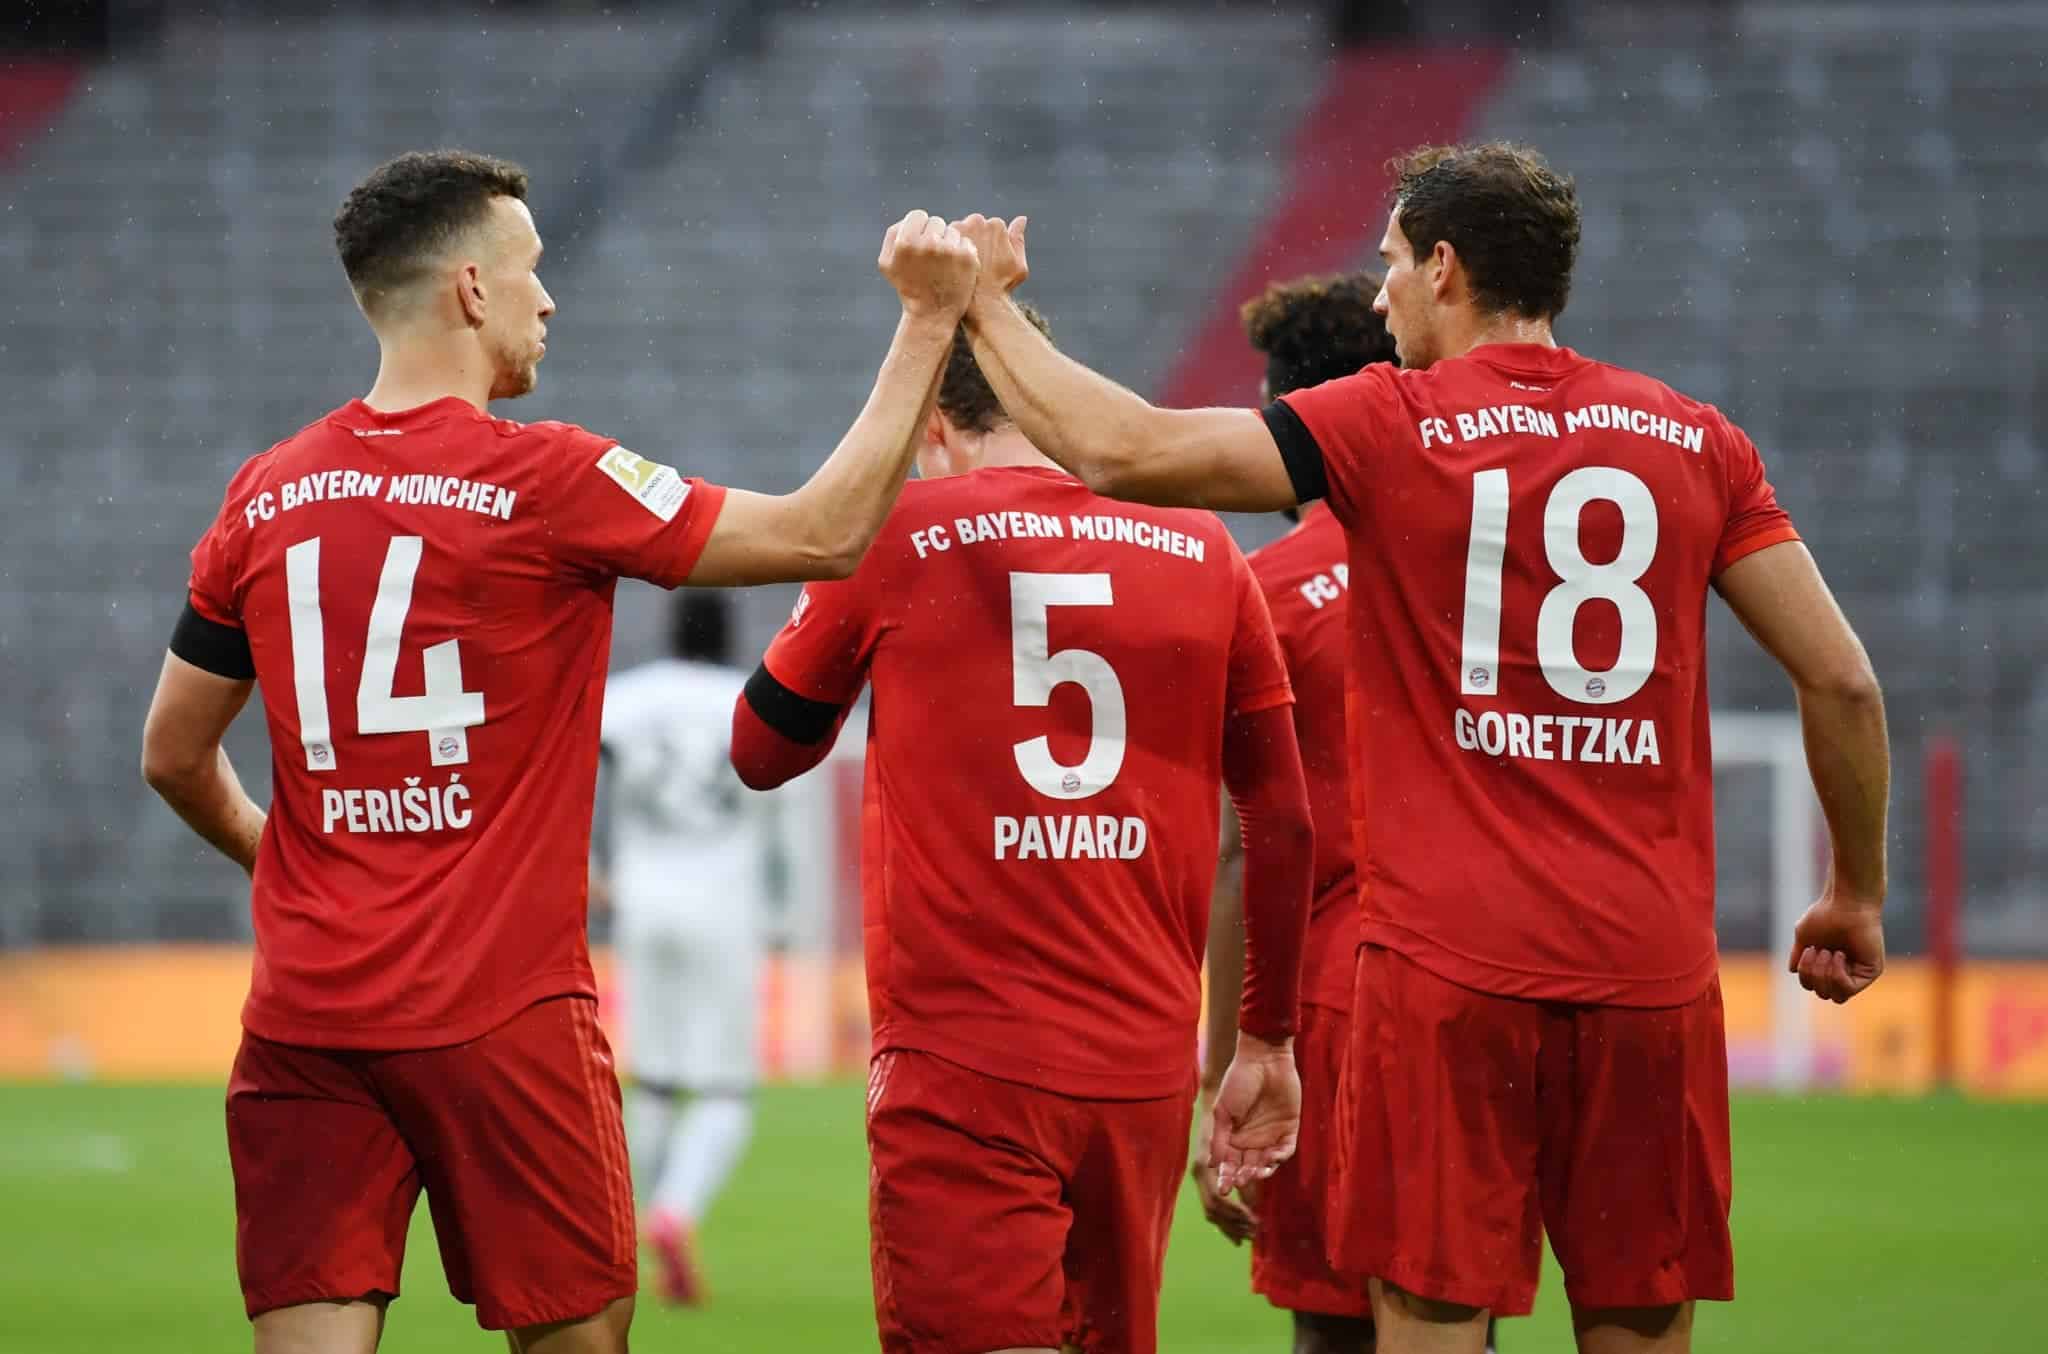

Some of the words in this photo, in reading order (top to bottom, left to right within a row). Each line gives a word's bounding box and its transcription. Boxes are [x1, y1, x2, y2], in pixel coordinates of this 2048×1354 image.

[1419, 417, 1454, 449] FC
[1455, 404, 1561, 442] BAYERN
[244, 491, 277, 529] FC
[280, 469, 384, 512] BAYERN
[910, 524, 951, 559] FC
[953, 511, 1065, 545] BAYERN
[1299, 574, 1340, 609] FC
[1460, 466, 1659, 704] 18
[285, 535, 486, 772] 14
[1008, 571, 1128, 800] 5
[1454, 708, 1662, 766] GORETZKA
[322, 772, 474, 834] PERIŠIĆ
[994, 815, 1148, 861] PAVARD
